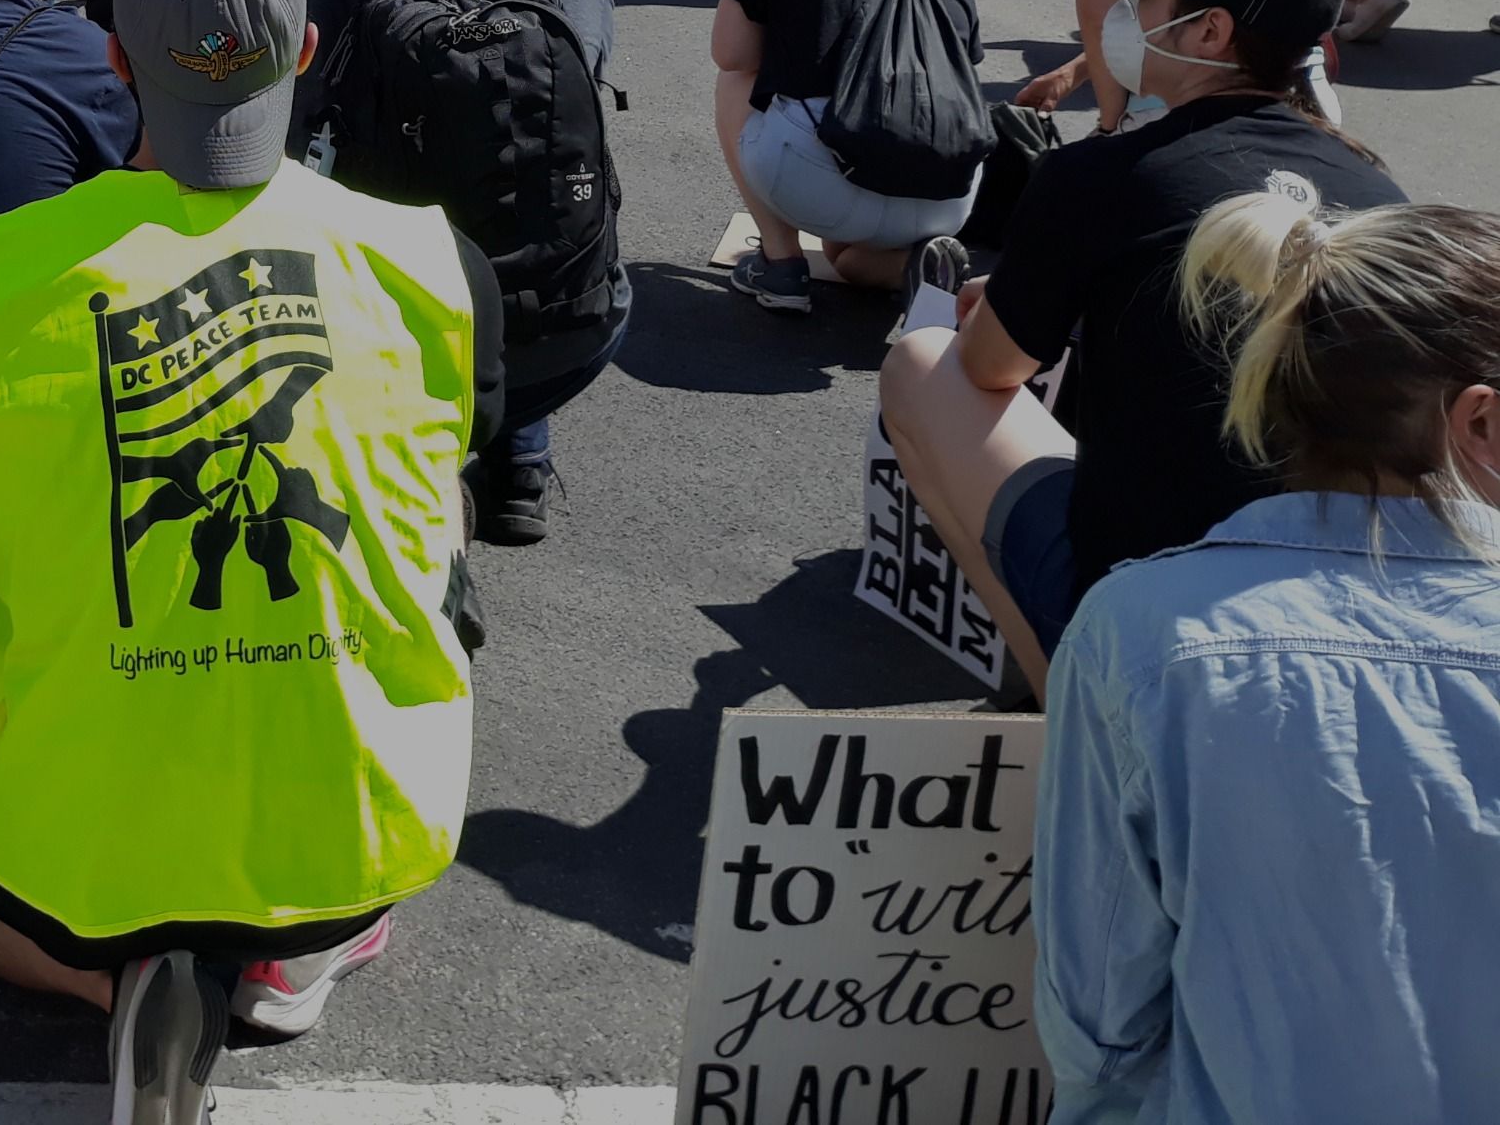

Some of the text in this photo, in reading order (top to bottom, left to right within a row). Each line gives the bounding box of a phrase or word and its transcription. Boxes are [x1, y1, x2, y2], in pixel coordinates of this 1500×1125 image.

[572, 183, 593, 201] 39
[121, 303, 317, 391] DC PEACE TEAM
[110, 642, 187, 681] Lighting
[193, 644, 218, 672] up
[225, 637, 302, 664] Human
[739, 734, 1025, 832] What
[723, 845, 836, 932] to
[714, 949, 1027, 1059] justice
